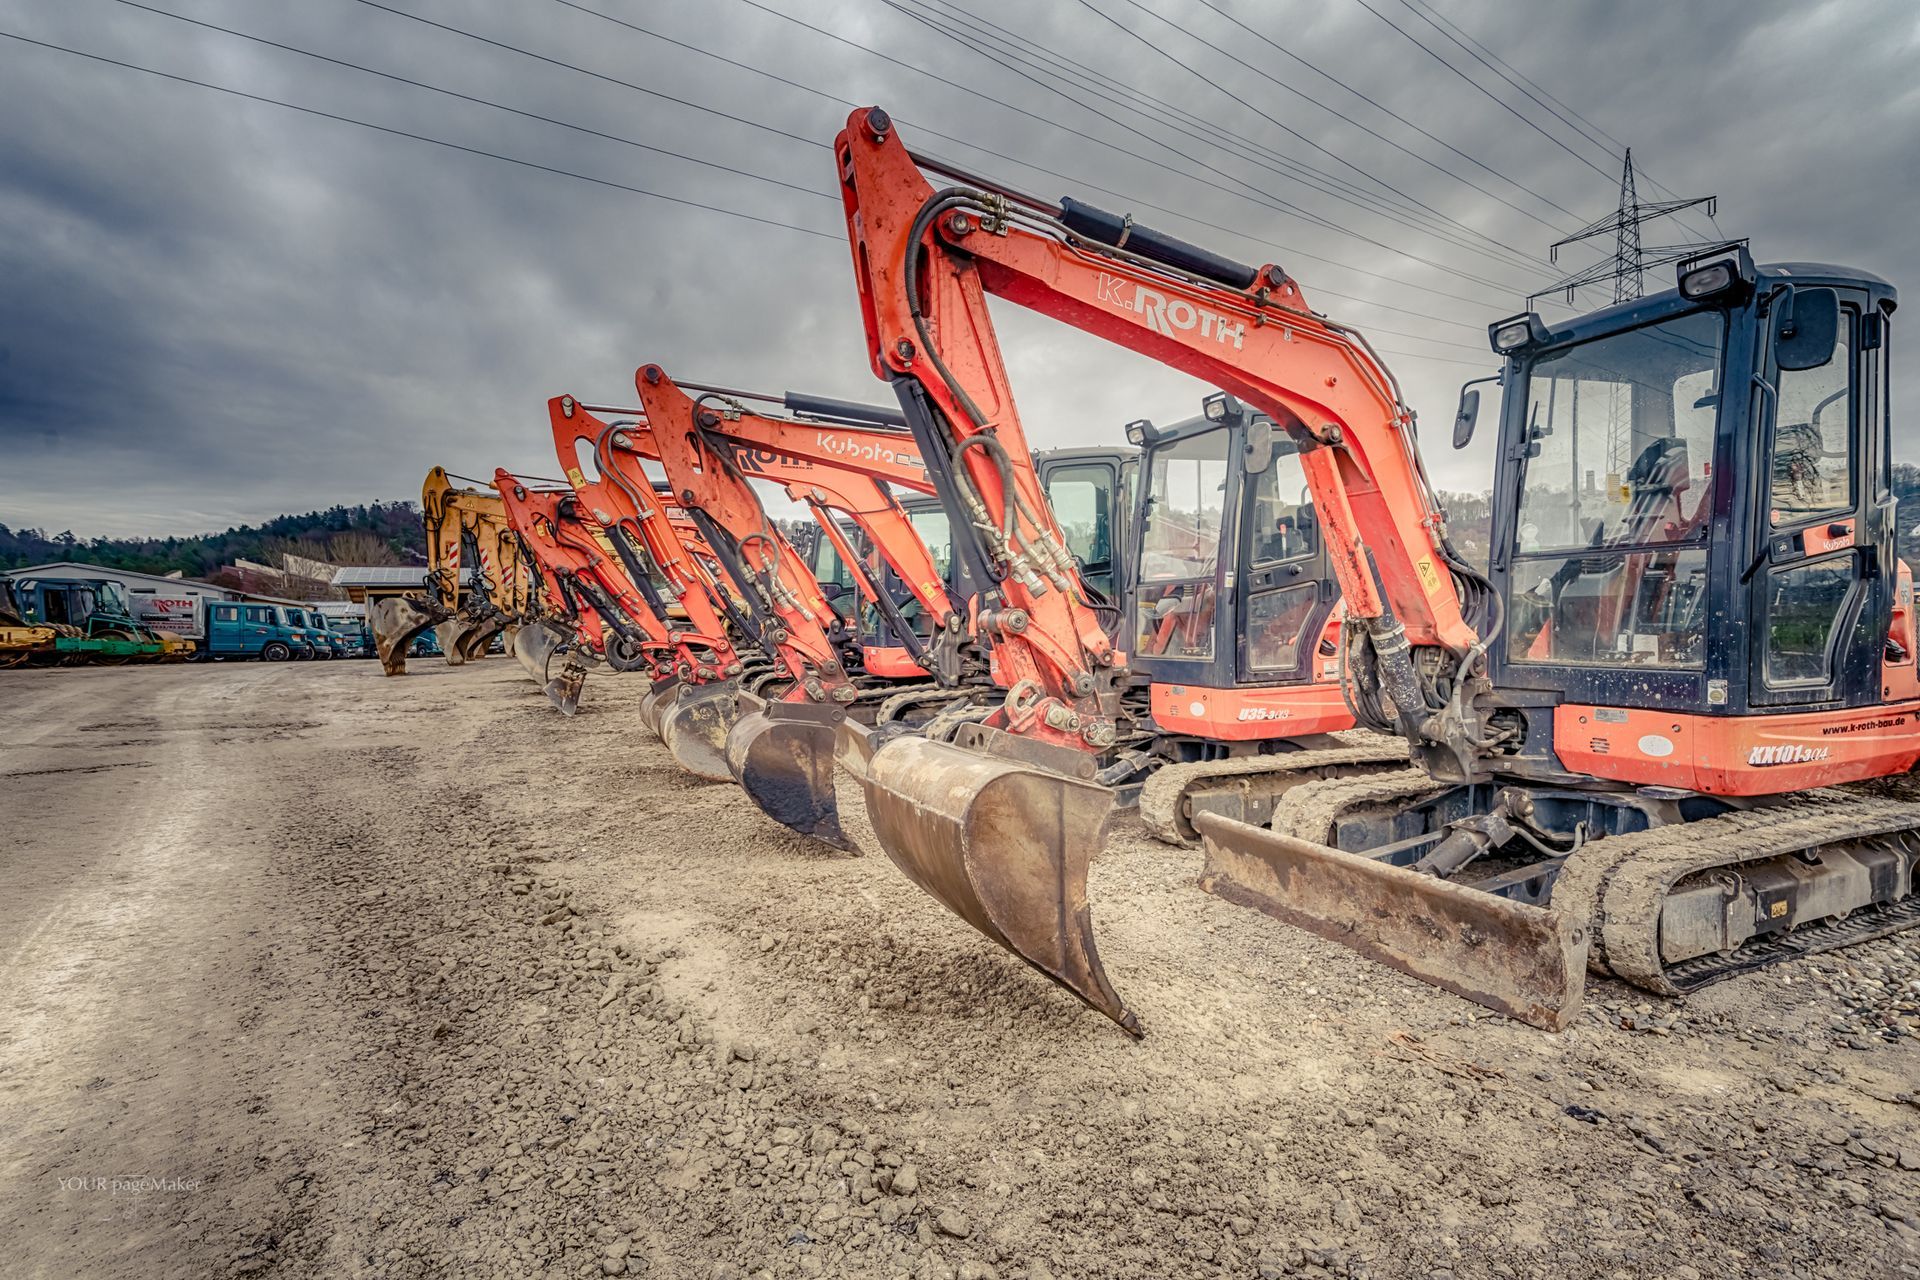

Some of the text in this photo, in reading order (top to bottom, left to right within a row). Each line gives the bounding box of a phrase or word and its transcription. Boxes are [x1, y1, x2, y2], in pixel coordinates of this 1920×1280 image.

[731, 445, 813, 473] RO
[816, 432, 894, 464] Kubota
[1823, 537, 1850, 550] Kubota
[1822, 716, 1906, 735] www.k-roth-bau.de
